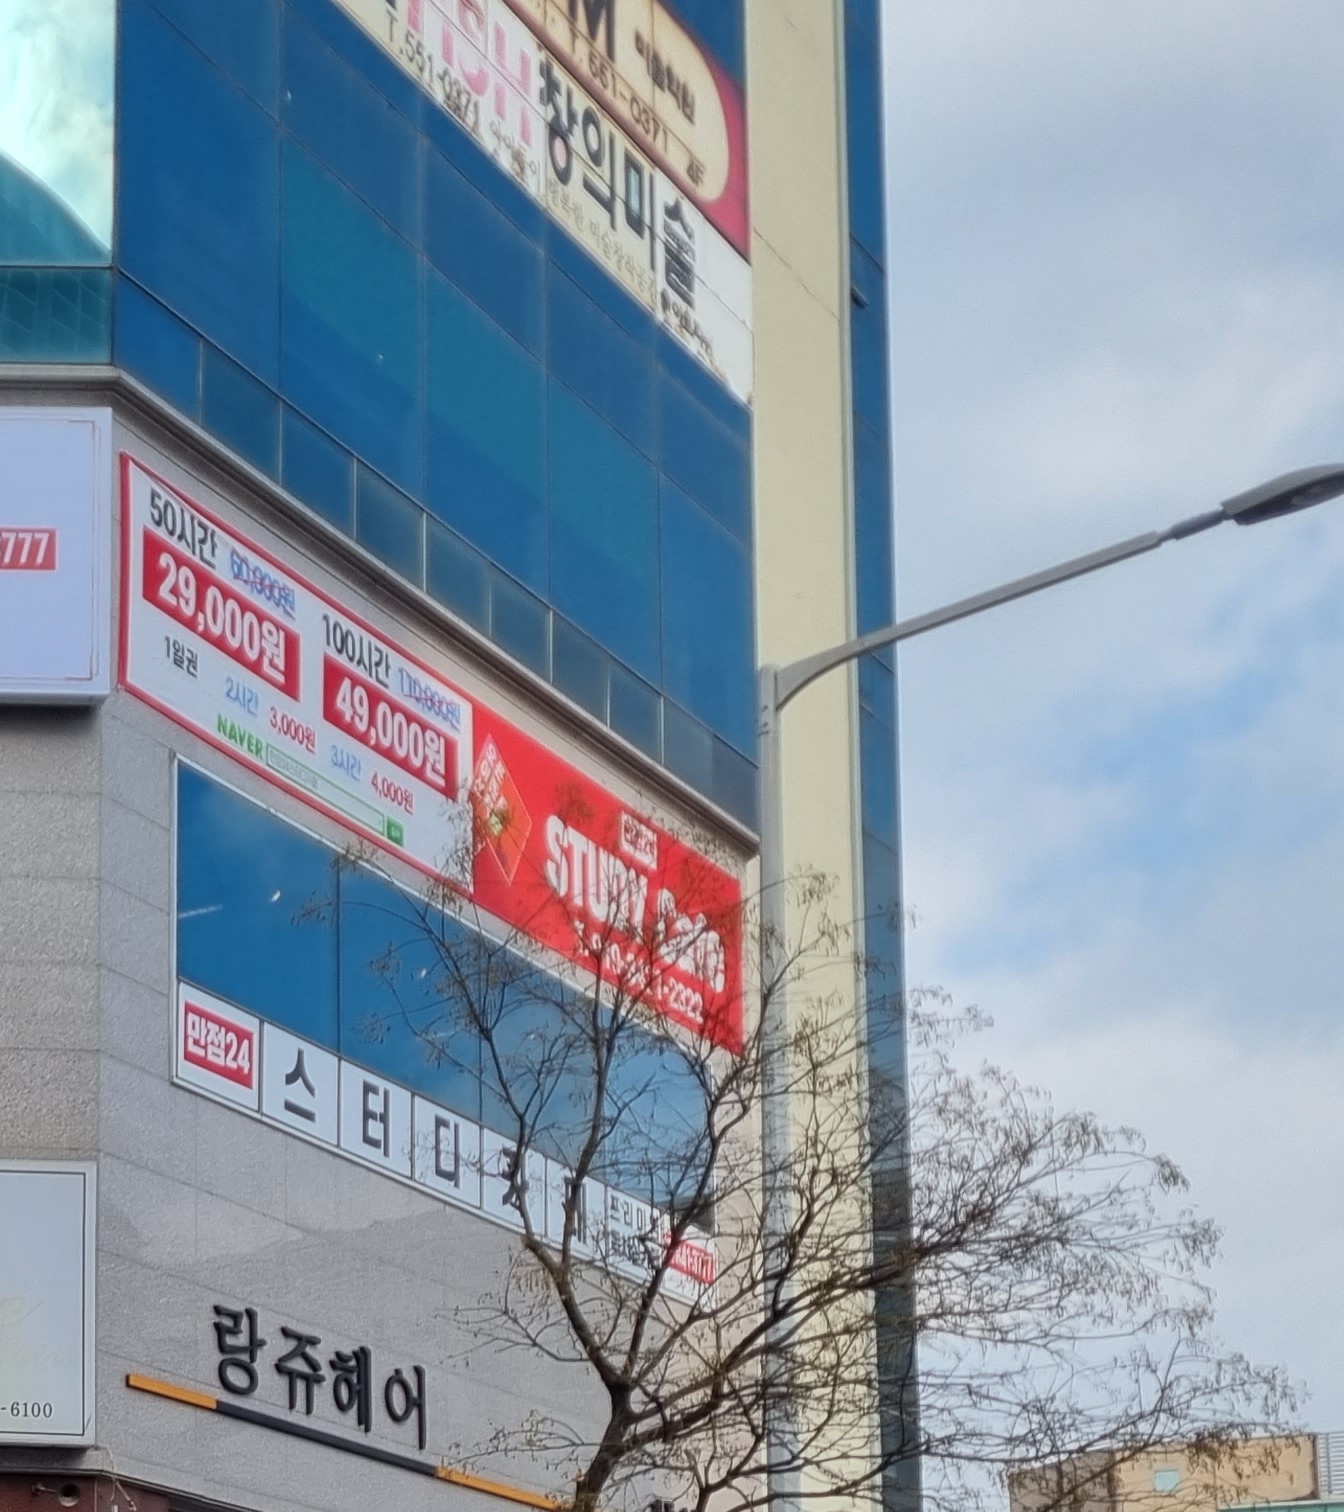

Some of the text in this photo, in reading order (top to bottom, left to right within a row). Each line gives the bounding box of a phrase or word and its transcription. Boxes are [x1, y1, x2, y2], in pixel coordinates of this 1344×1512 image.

[150, 490, 218, 568] 50시간
[158, 552, 287, 686] 29,000원
[321, 614, 392, 689] 100시간
[164, 634, 317, 755] 1일권 2시간 3,000원
[217, 712, 264, 760] NAVER
[336, 676, 448, 789] 49,000원
[330, 744, 362, 782] 3시간
[371, 770, 414, 816] 4,000원
[545, 814, 648, 942] STUDY
[186, 1008, 251, 1077] 만점24
[212, 1304, 429, 1451] 랑쥬헤어
